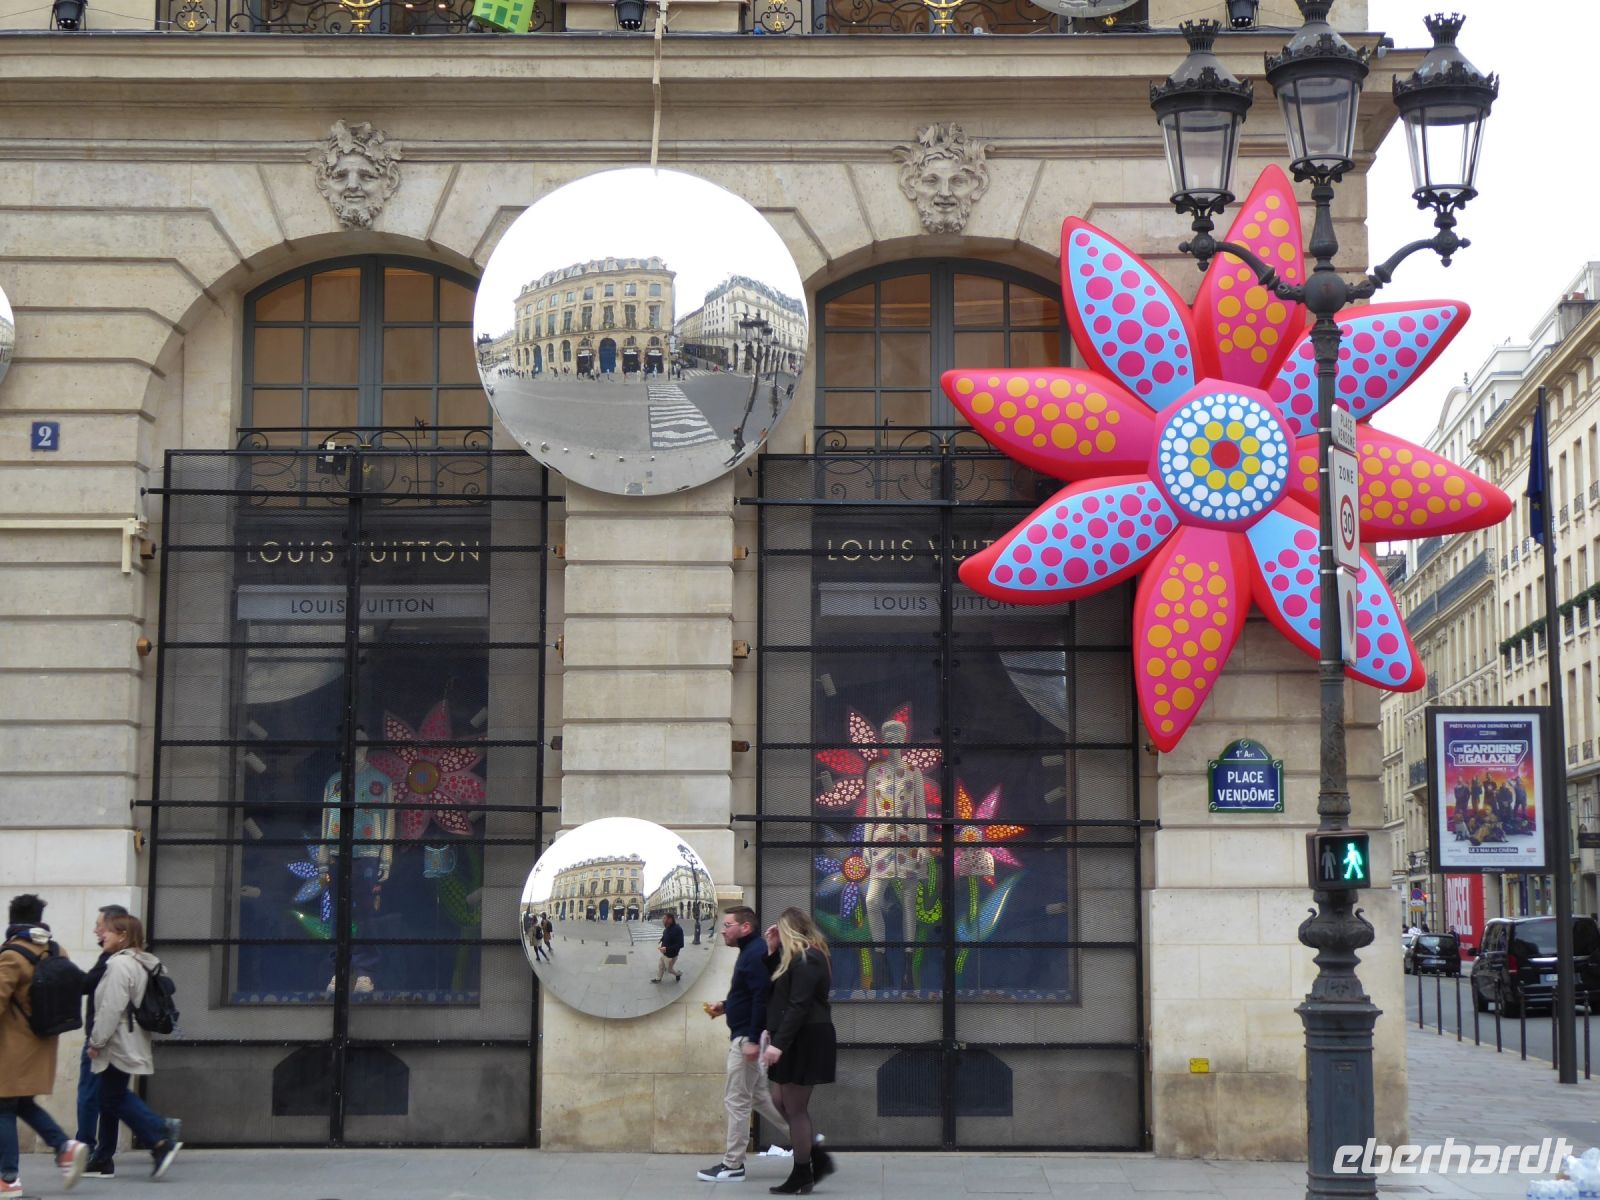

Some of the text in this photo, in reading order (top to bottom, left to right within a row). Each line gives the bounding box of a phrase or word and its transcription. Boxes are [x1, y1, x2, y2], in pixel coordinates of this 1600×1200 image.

[38, 425, 52, 446] 2
[1339, 465, 1354, 485] ZONE
[1343, 511, 1352, 535] 30
[247, 541, 479, 563] LOUIS UITTON
[828, 539, 914, 561] LOUIS
[291, 599, 434, 614] LOUIS UITTON
[874, 596, 928, 610] LOUIS
[1463, 744, 1522, 754] GARDIENS
[1465, 754, 1516, 763] GALAXIE
[1227, 771, 1264, 783] PLACE
[1217, 787, 1275, 801] VENDÔME
[1447, 877, 1473, 936] DIESEL
